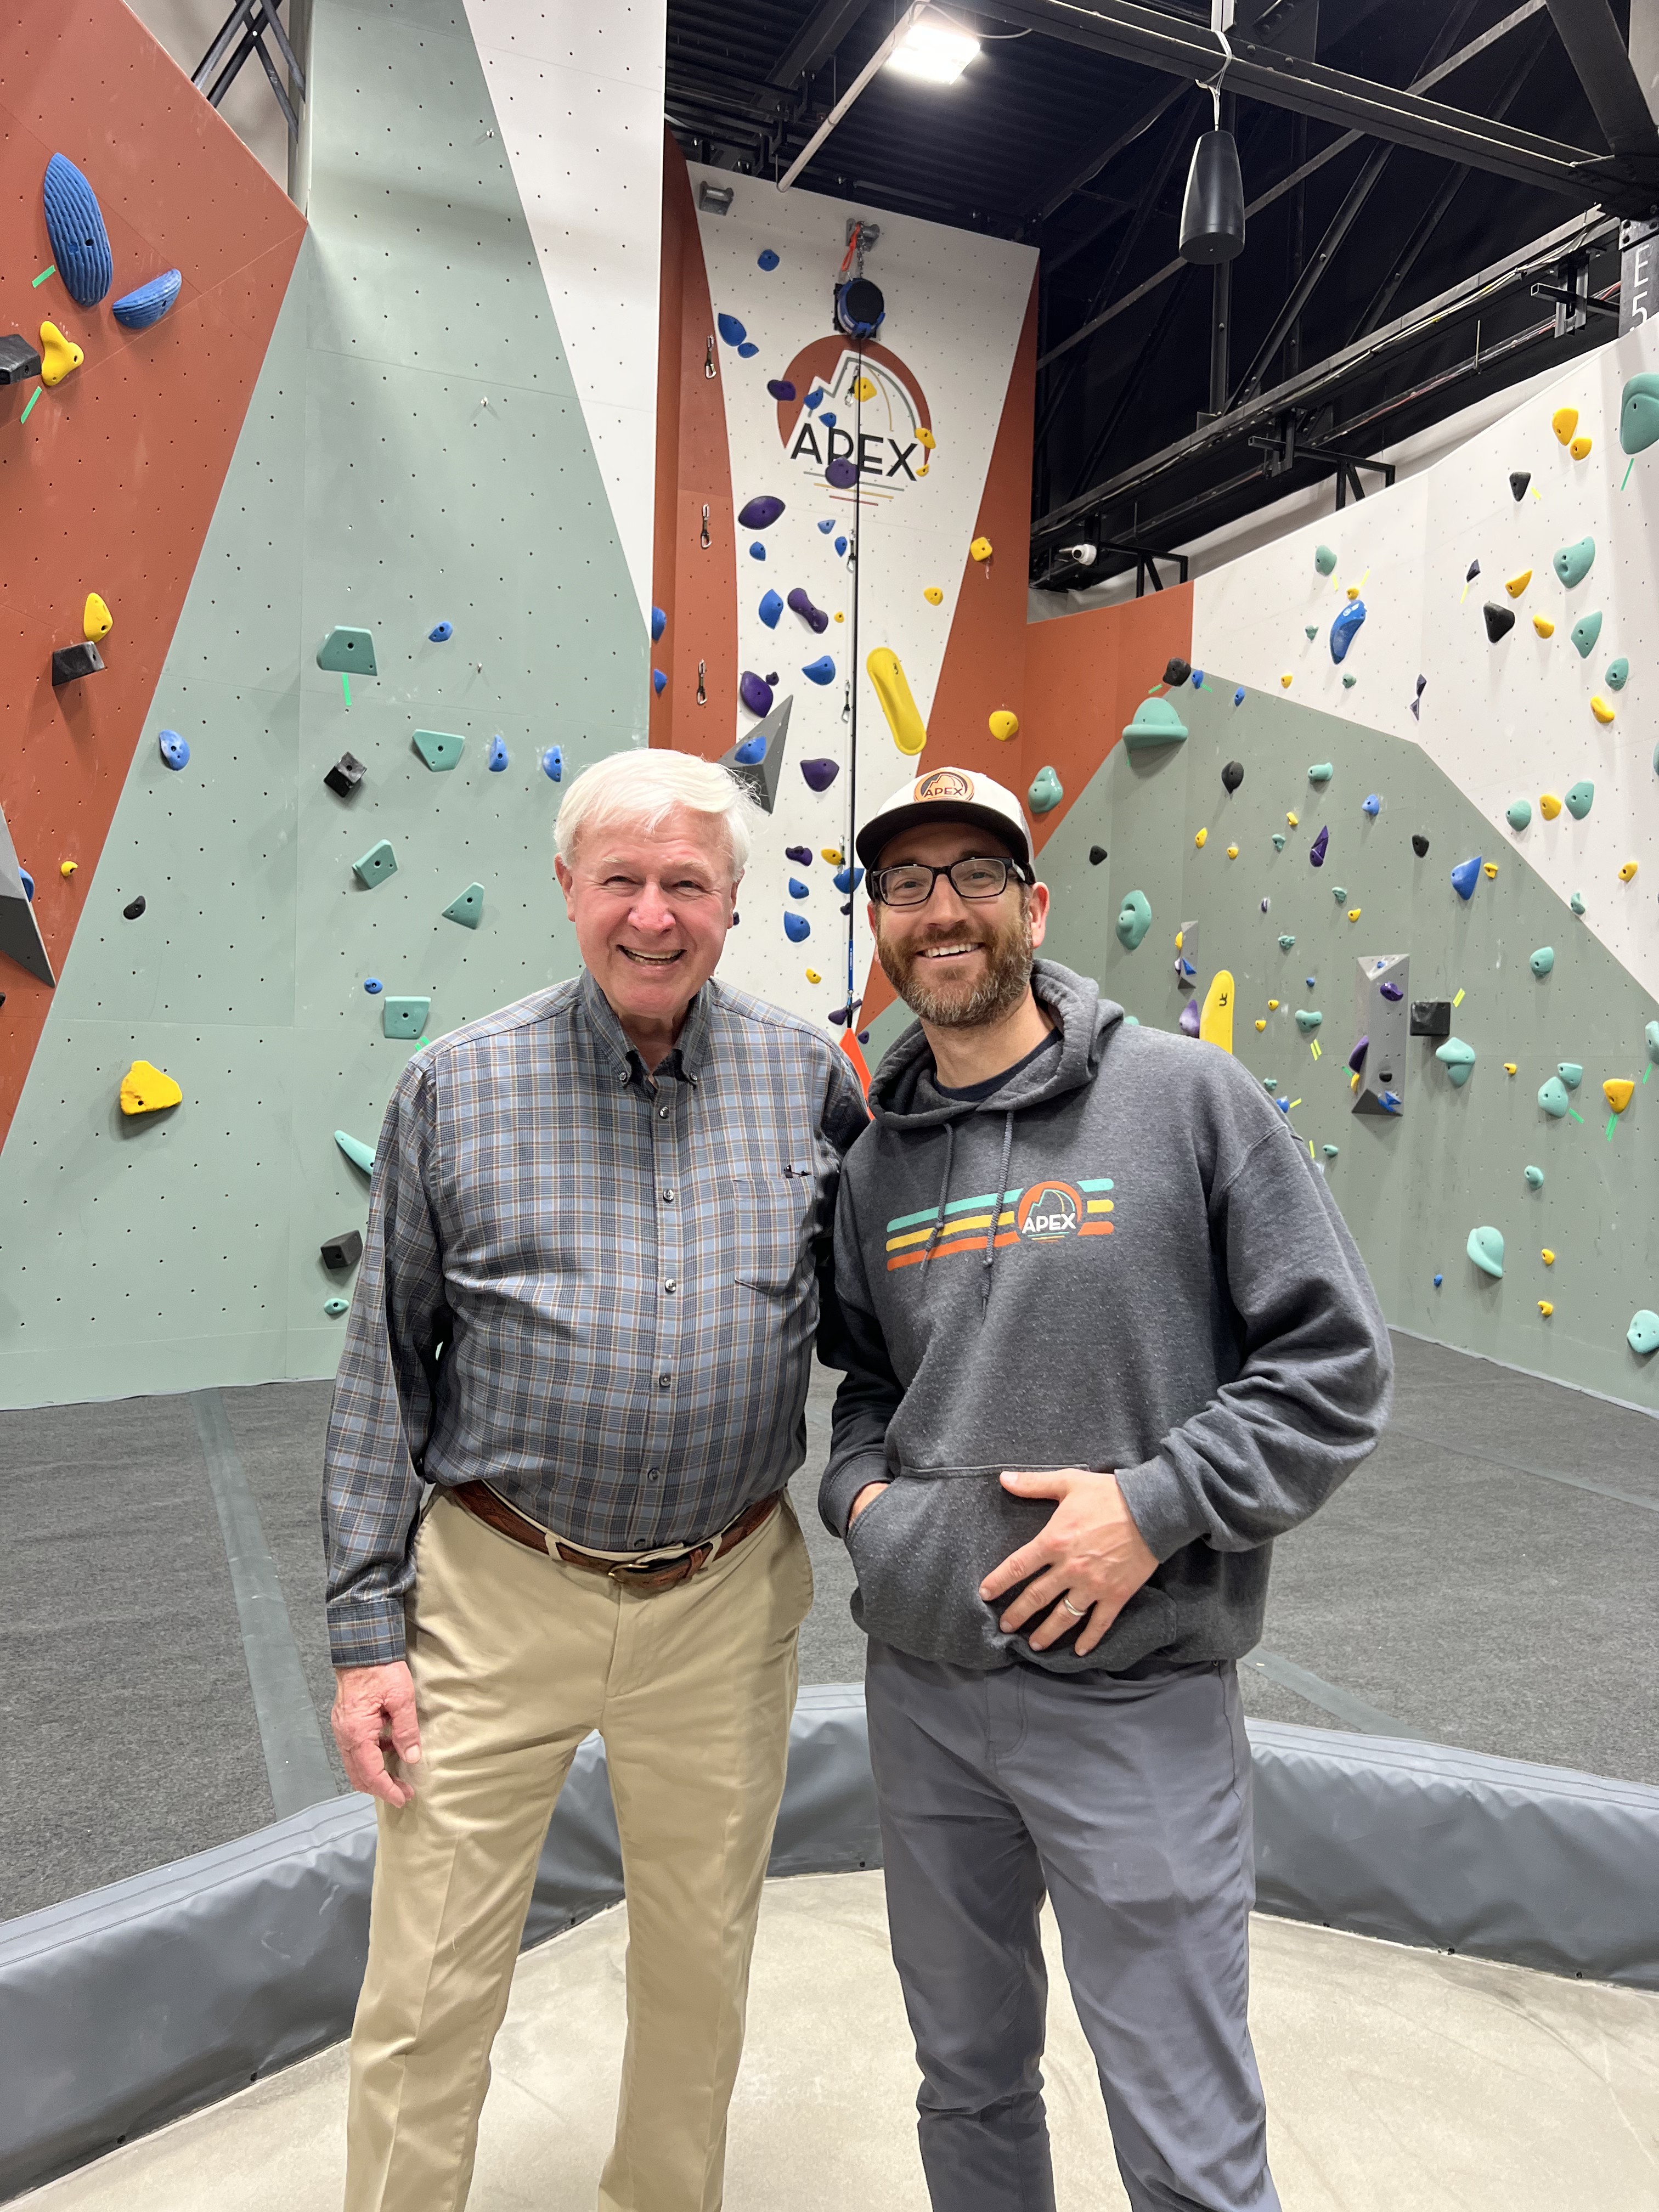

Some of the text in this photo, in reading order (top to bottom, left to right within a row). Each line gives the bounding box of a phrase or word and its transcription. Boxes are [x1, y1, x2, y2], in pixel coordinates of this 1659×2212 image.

[790, 422, 918, 482] APEX
[923, 787, 963, 798] APEX
[1022, 1212, 1076, 1234] APEX
